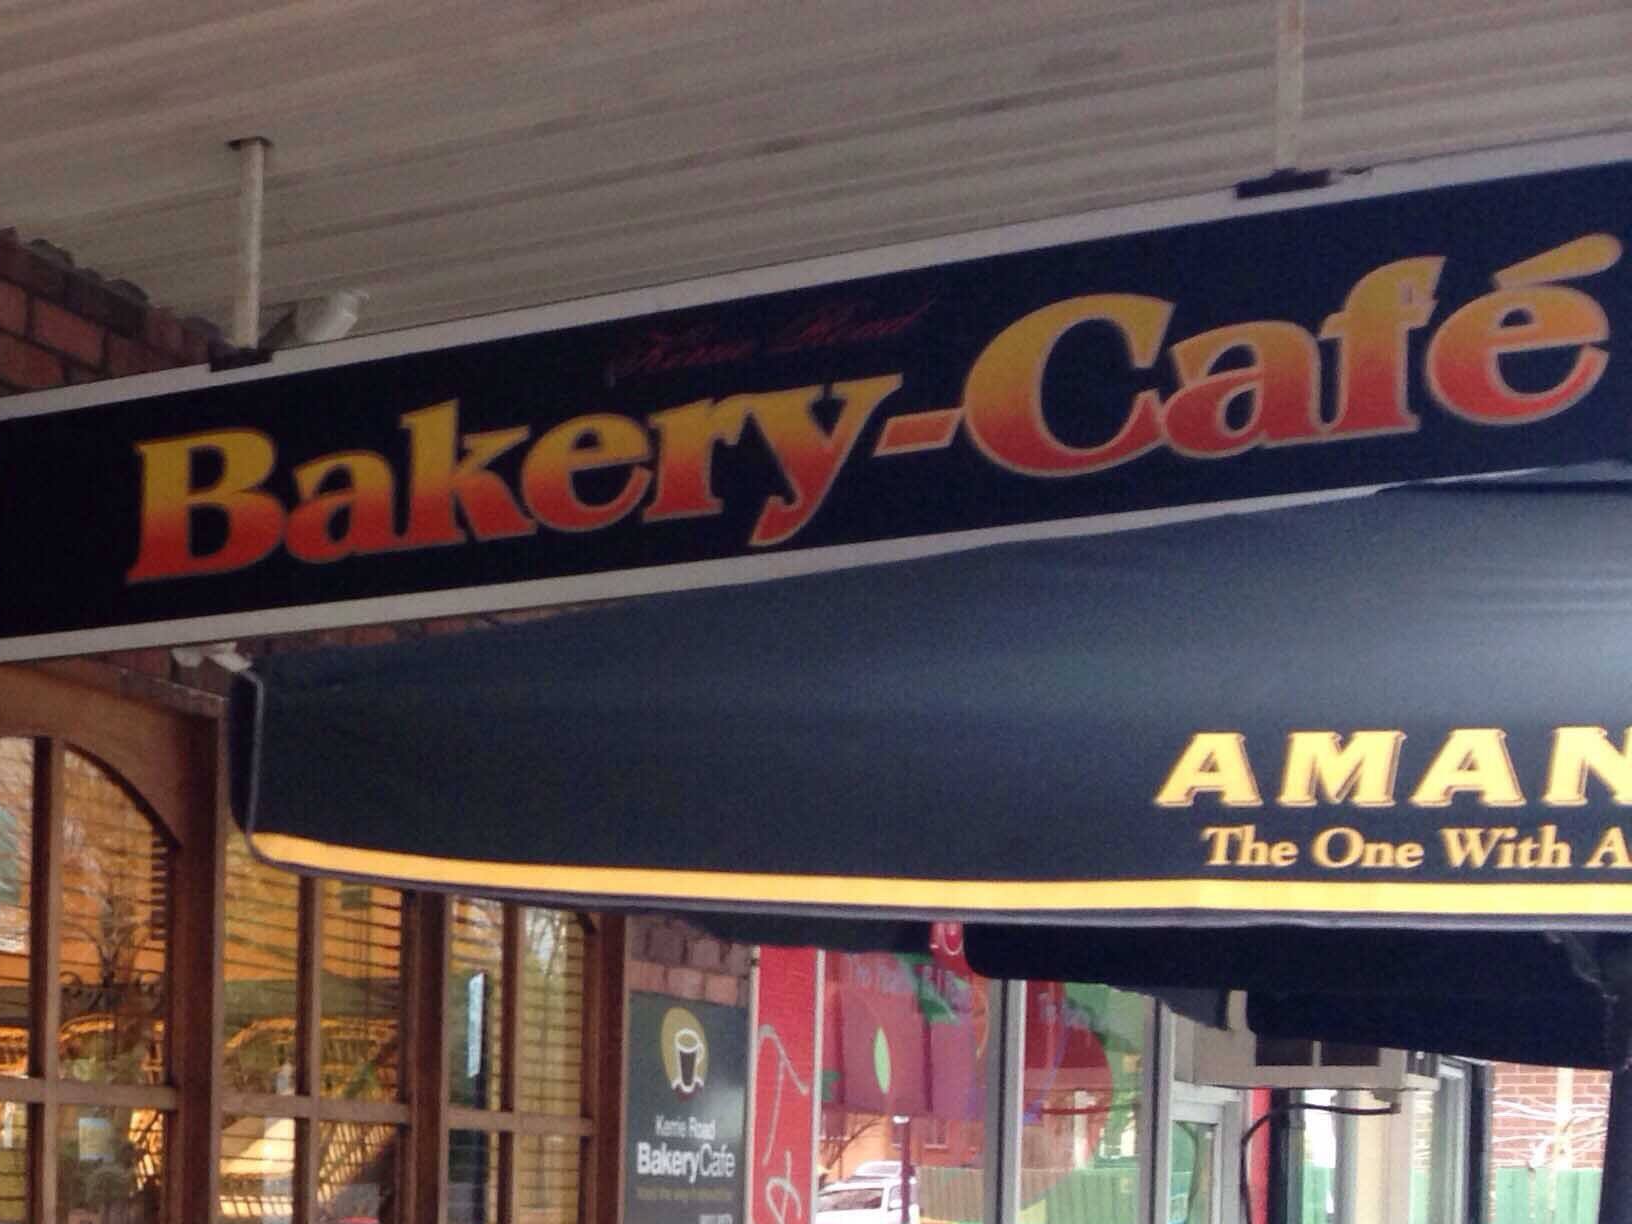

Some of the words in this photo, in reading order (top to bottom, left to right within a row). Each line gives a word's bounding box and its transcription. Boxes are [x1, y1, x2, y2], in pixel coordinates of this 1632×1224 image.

[126, 231, 1624, 584] Bakery-Café
[1200, 824, 1299, 867] The
[1311, 826, 1425, 868] One
[1440, 825, 1572, 868] With
